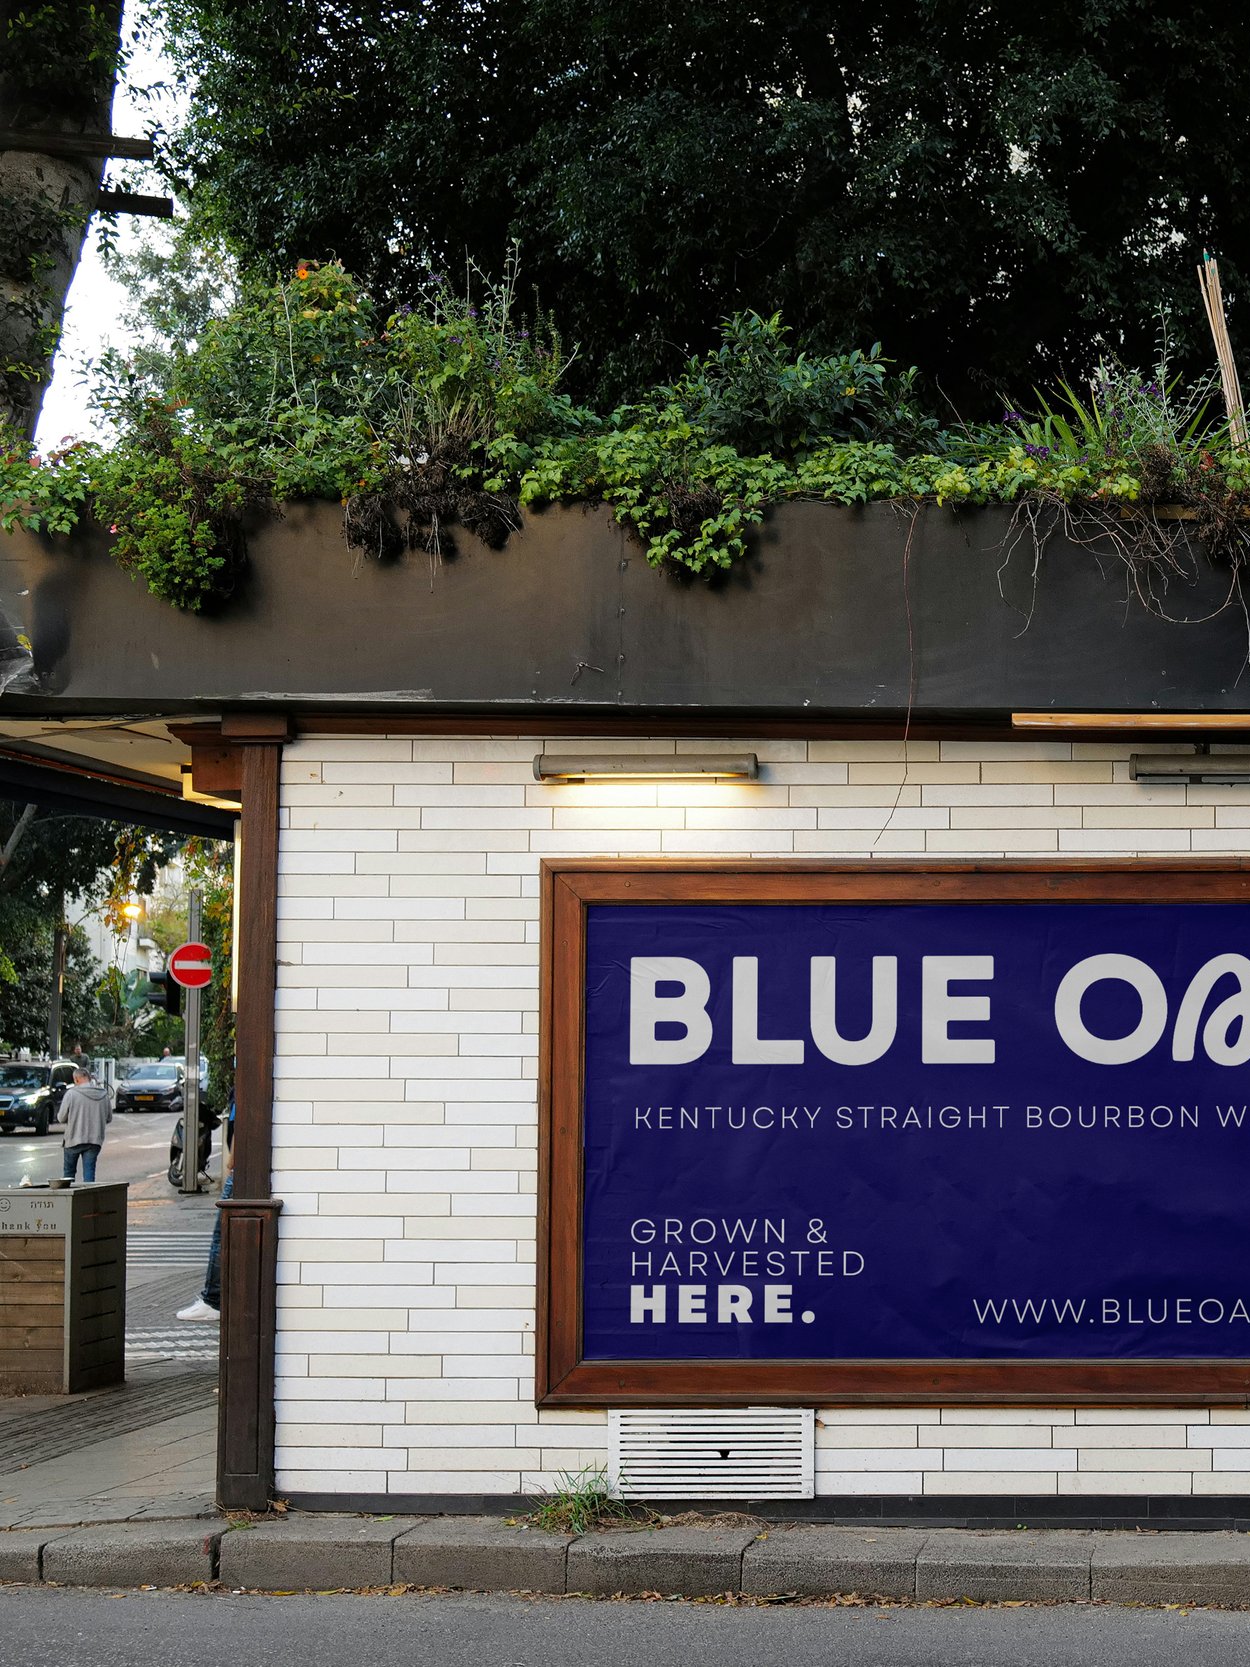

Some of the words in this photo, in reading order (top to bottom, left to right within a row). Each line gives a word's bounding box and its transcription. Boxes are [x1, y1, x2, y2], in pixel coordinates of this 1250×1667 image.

[629, 955, 996, 1066] BLUE
[635, 1106, 821, 1129] KENTUCKY
[836, 1105, 1010, 1129] STRAIGHT
[1026, 1105, 1199, 1128] BOURBON
[0, 1221, 30, 1230] hank
[630, 1218, 785, 1244] GROWN
[806, 1218, 827, 1244] &
[631, 1251, 865, 1277] HARVESTED
[630, 1284, 816, 1324] HERE.
